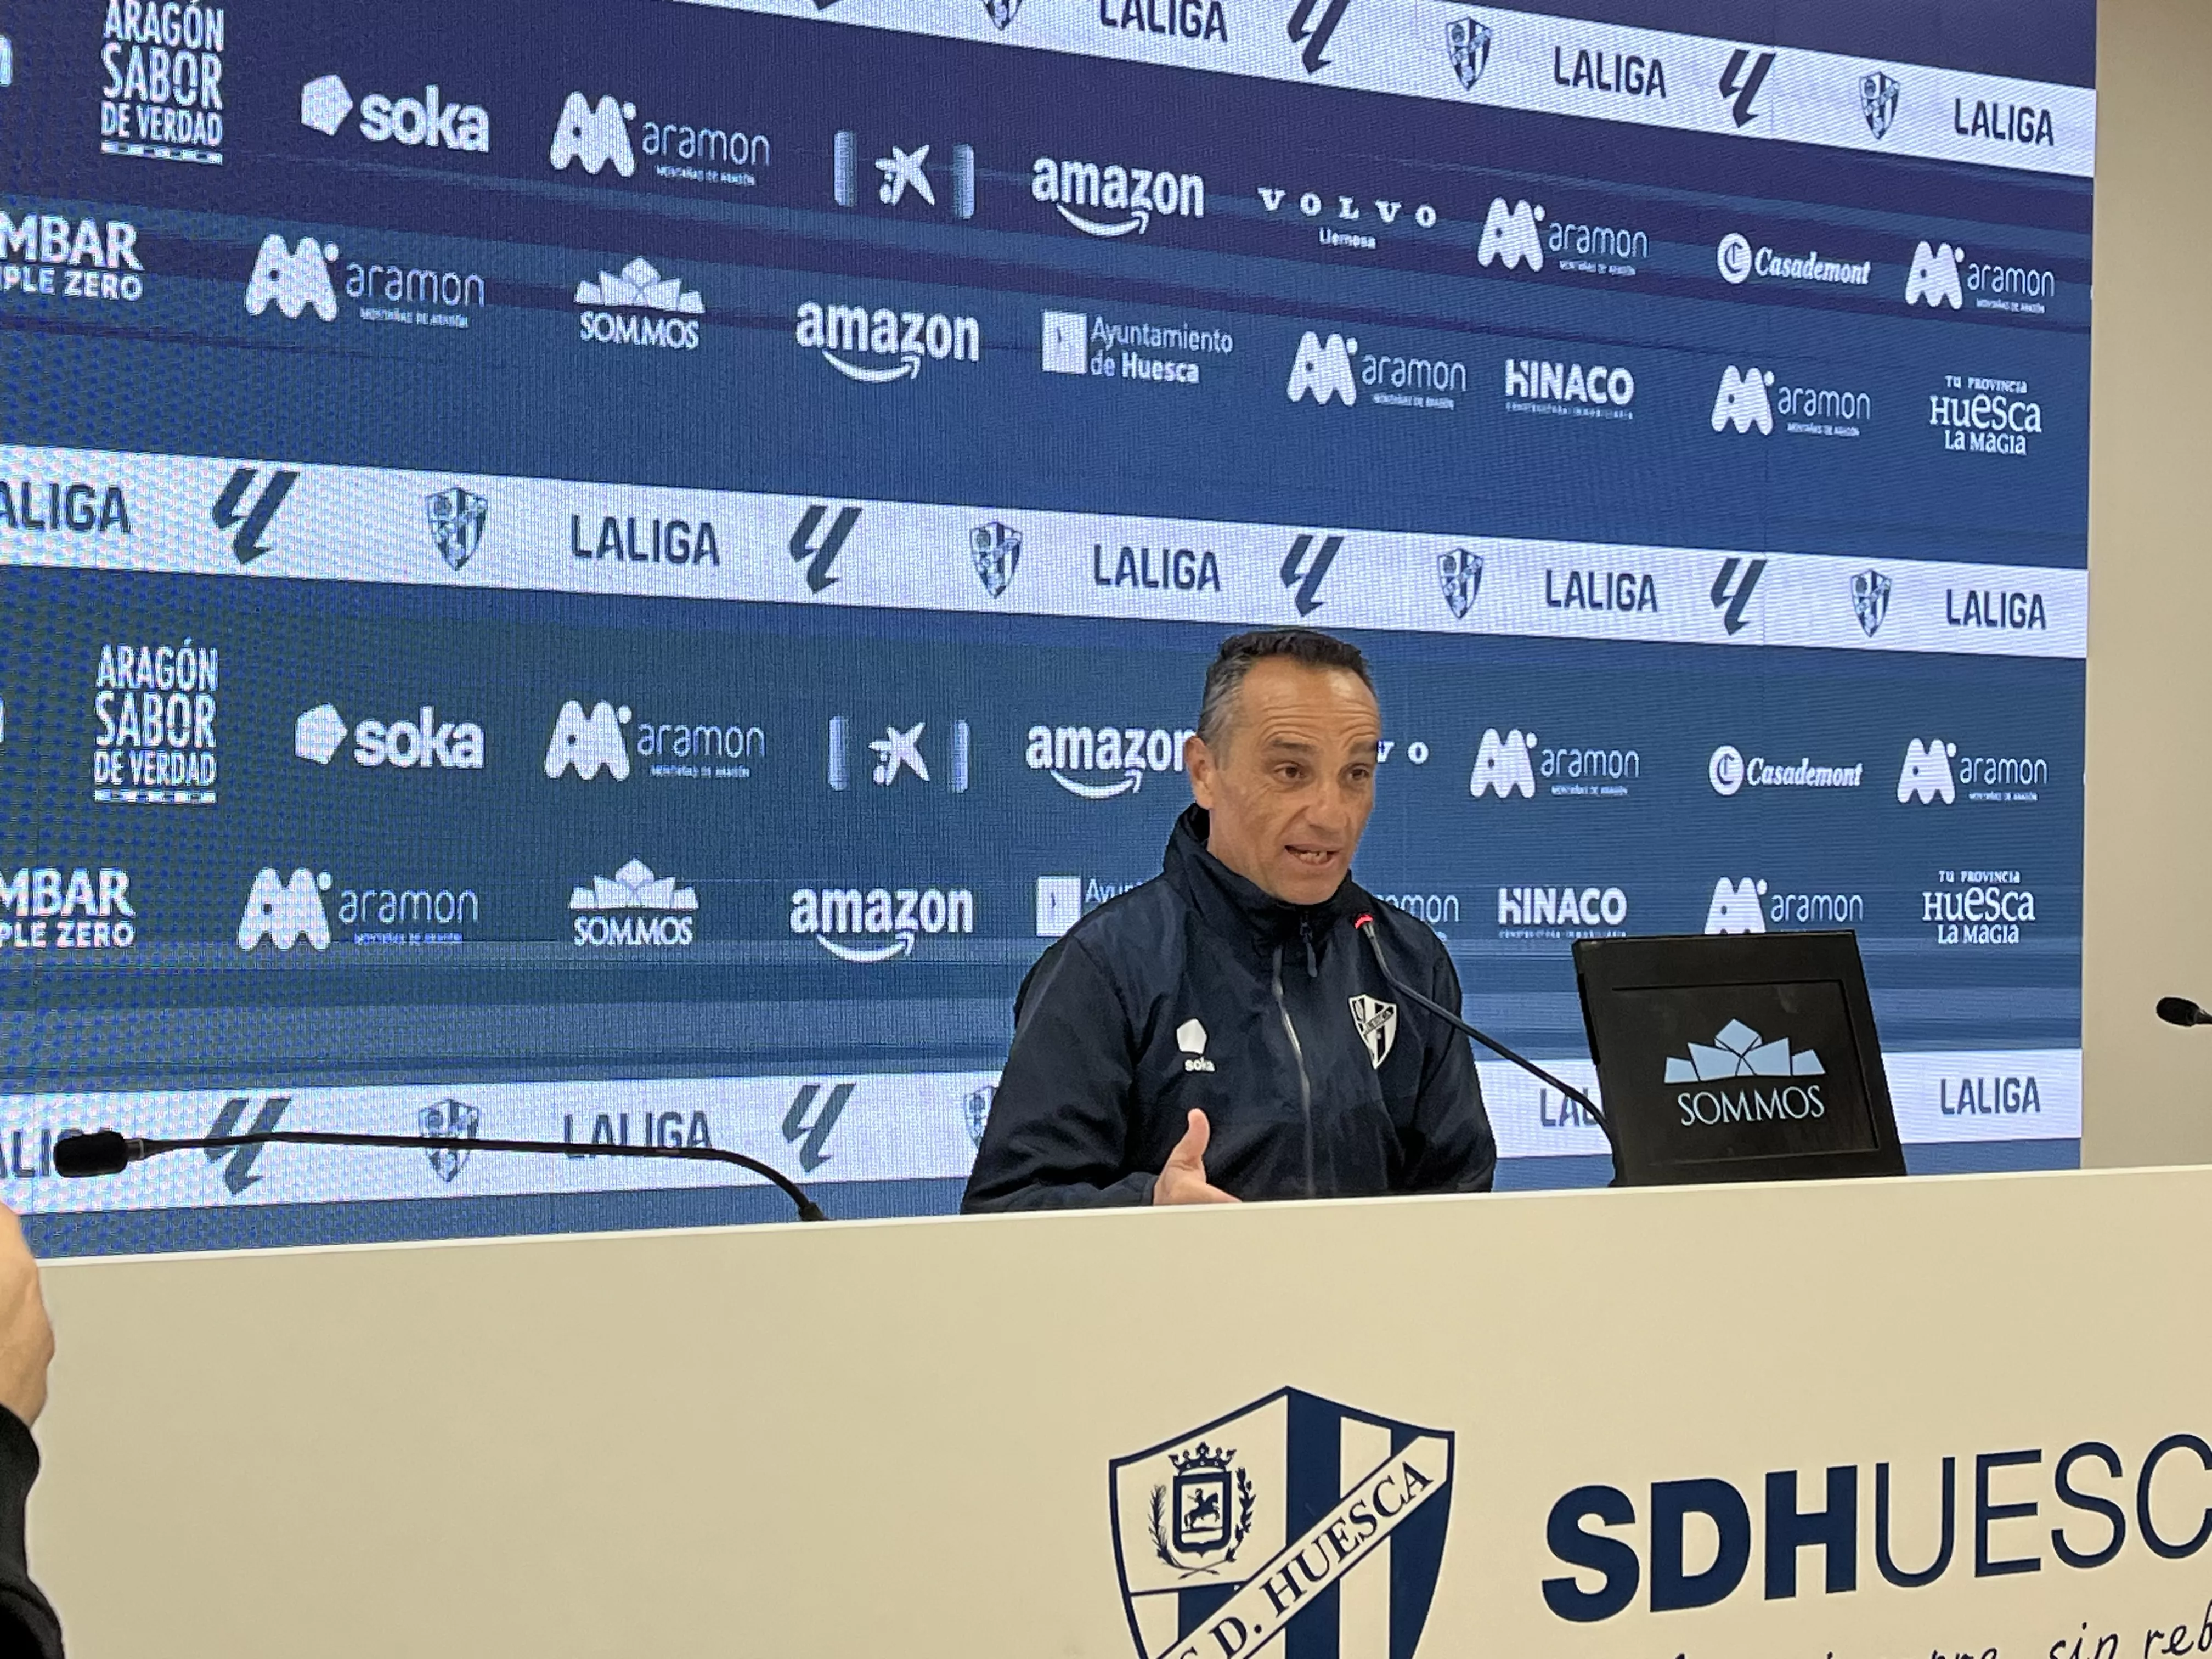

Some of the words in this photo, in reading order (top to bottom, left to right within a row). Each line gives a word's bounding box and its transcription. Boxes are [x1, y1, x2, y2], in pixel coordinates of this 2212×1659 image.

[1099, 0, 1228, 42] LALIGA
[100, 42, 223, 110] SABOR
[1554, 46, 1666, 98] LALIGA
[100, 100, 131, 138] DE
[136, 104, 223, 147] VERDAD
[359, 84, 489, 153] soka
[1954, 98, 2054, 146] LALIGA
[642, 121, 770, 166] aramon
[1031, 156, 1205, 218] amazon
[0, 211, 145, 271] MBAR
[1548, 222, 1649, 258] aramon
[63, 270, 143, 301] ZERO
[346, 262, 485, 307] aramon
[1755, 246, 1871, 284] Casademont
[1967, 263, 2055, 297] aramon
[579, 311, 700, 350] SOMMOS
[795, 301, 979, 363] amazon
[1090, 315, 1233, 354] Ayuntamiento
[1091, 349, 1116, 377] de
[1121, 351, 1200, 384] Huesca
[1362, 354, 1467, 392] aramon
[1505, 358, 1634, 405] HINACO
[1778, 386, 1870, 420] aramon
[571, 514, 720, 566] LALIGA
[1093, 543, 1221, 592] LALIGA
[1545, 568, 1658, 612] LALIGA
[1946, 588, 2046, 630] LALIGA
[95, 636, 219, 692] ARAGÓN
[94, 690, 217, 748] SABOR
[354, 704, 486, 769] soka
[637, 723, 765, 758] aramon
[94, 749, 124, 785] DE
[129, 749, 217, 786] VERDAD
[1540, 748, 1640, 779] aramon
[1747, 757, 1863, 786] Casademont
[1960, 757, 2047, 785] aramon
[338, 888, 478, 924] aramon
[789, 886, 974, 934] amazon
[1498, 887, 1627, 925] HINACO
[1771, 895, 1864, 922] aramon
[57, 921, 135, 948] ZERO
[573, 915, 693, 947] SOMMOS
[1185, 1057, 1215, 1071] soka
[1678, 1085, 1825, 1126] SOMMOS
[1940, 1075, 2041, 1115] LALIGA
[1260, 1461, 1434, 1617] HUESCA
